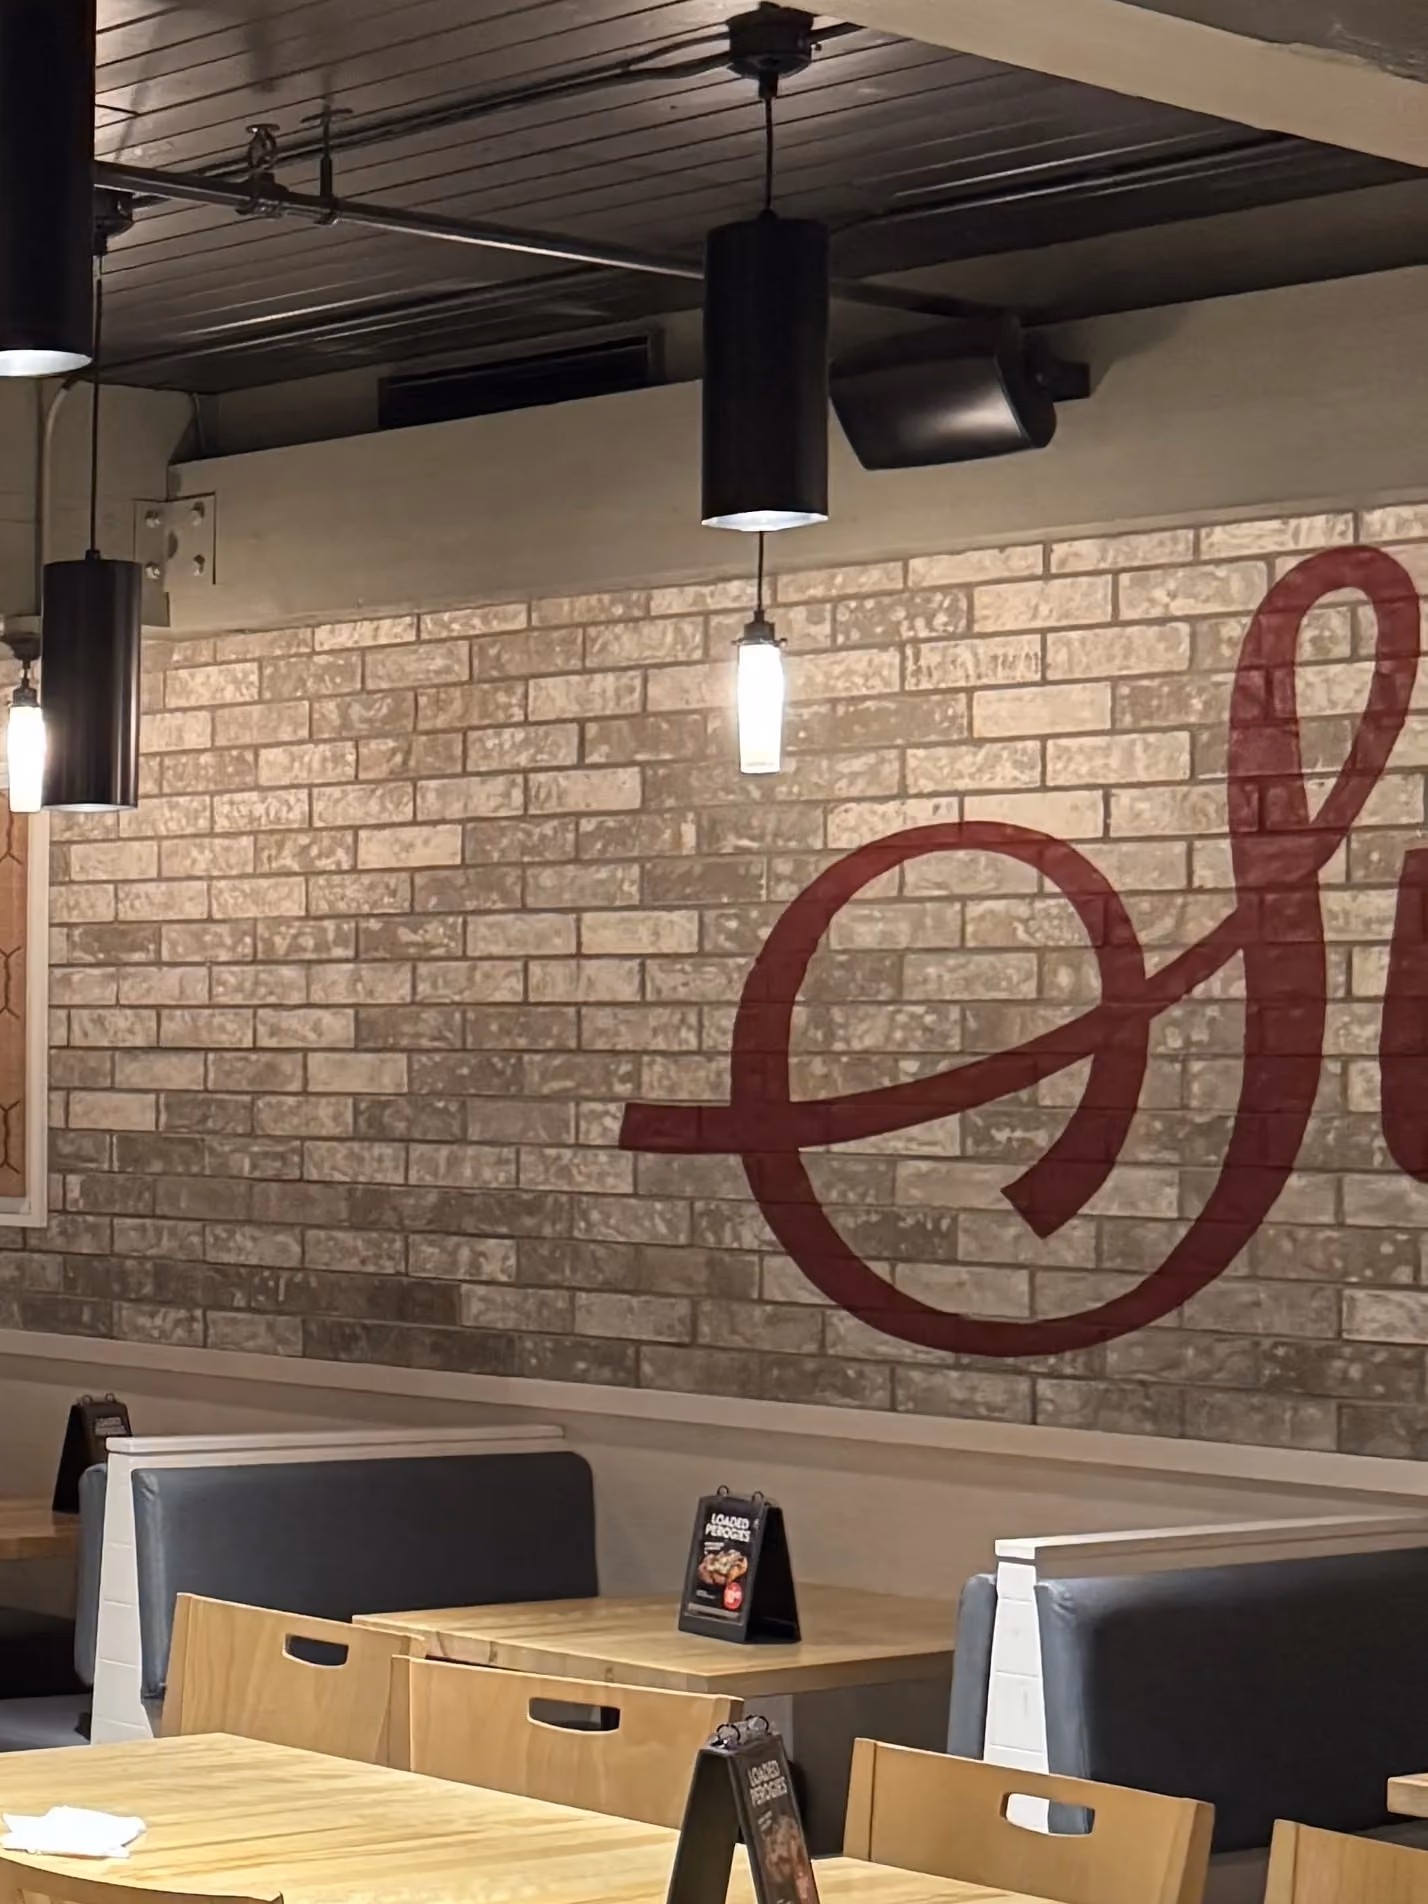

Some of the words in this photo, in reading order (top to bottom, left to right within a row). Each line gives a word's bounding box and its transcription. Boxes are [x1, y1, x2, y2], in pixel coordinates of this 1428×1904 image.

[705, 1523, 751, 1542] PEROGIES
[711, 1513, 750, 1529] LOADED
[748, 1760, 780, 1787] LOADED
[750, 1776, 788, 1806] PEROGIES
